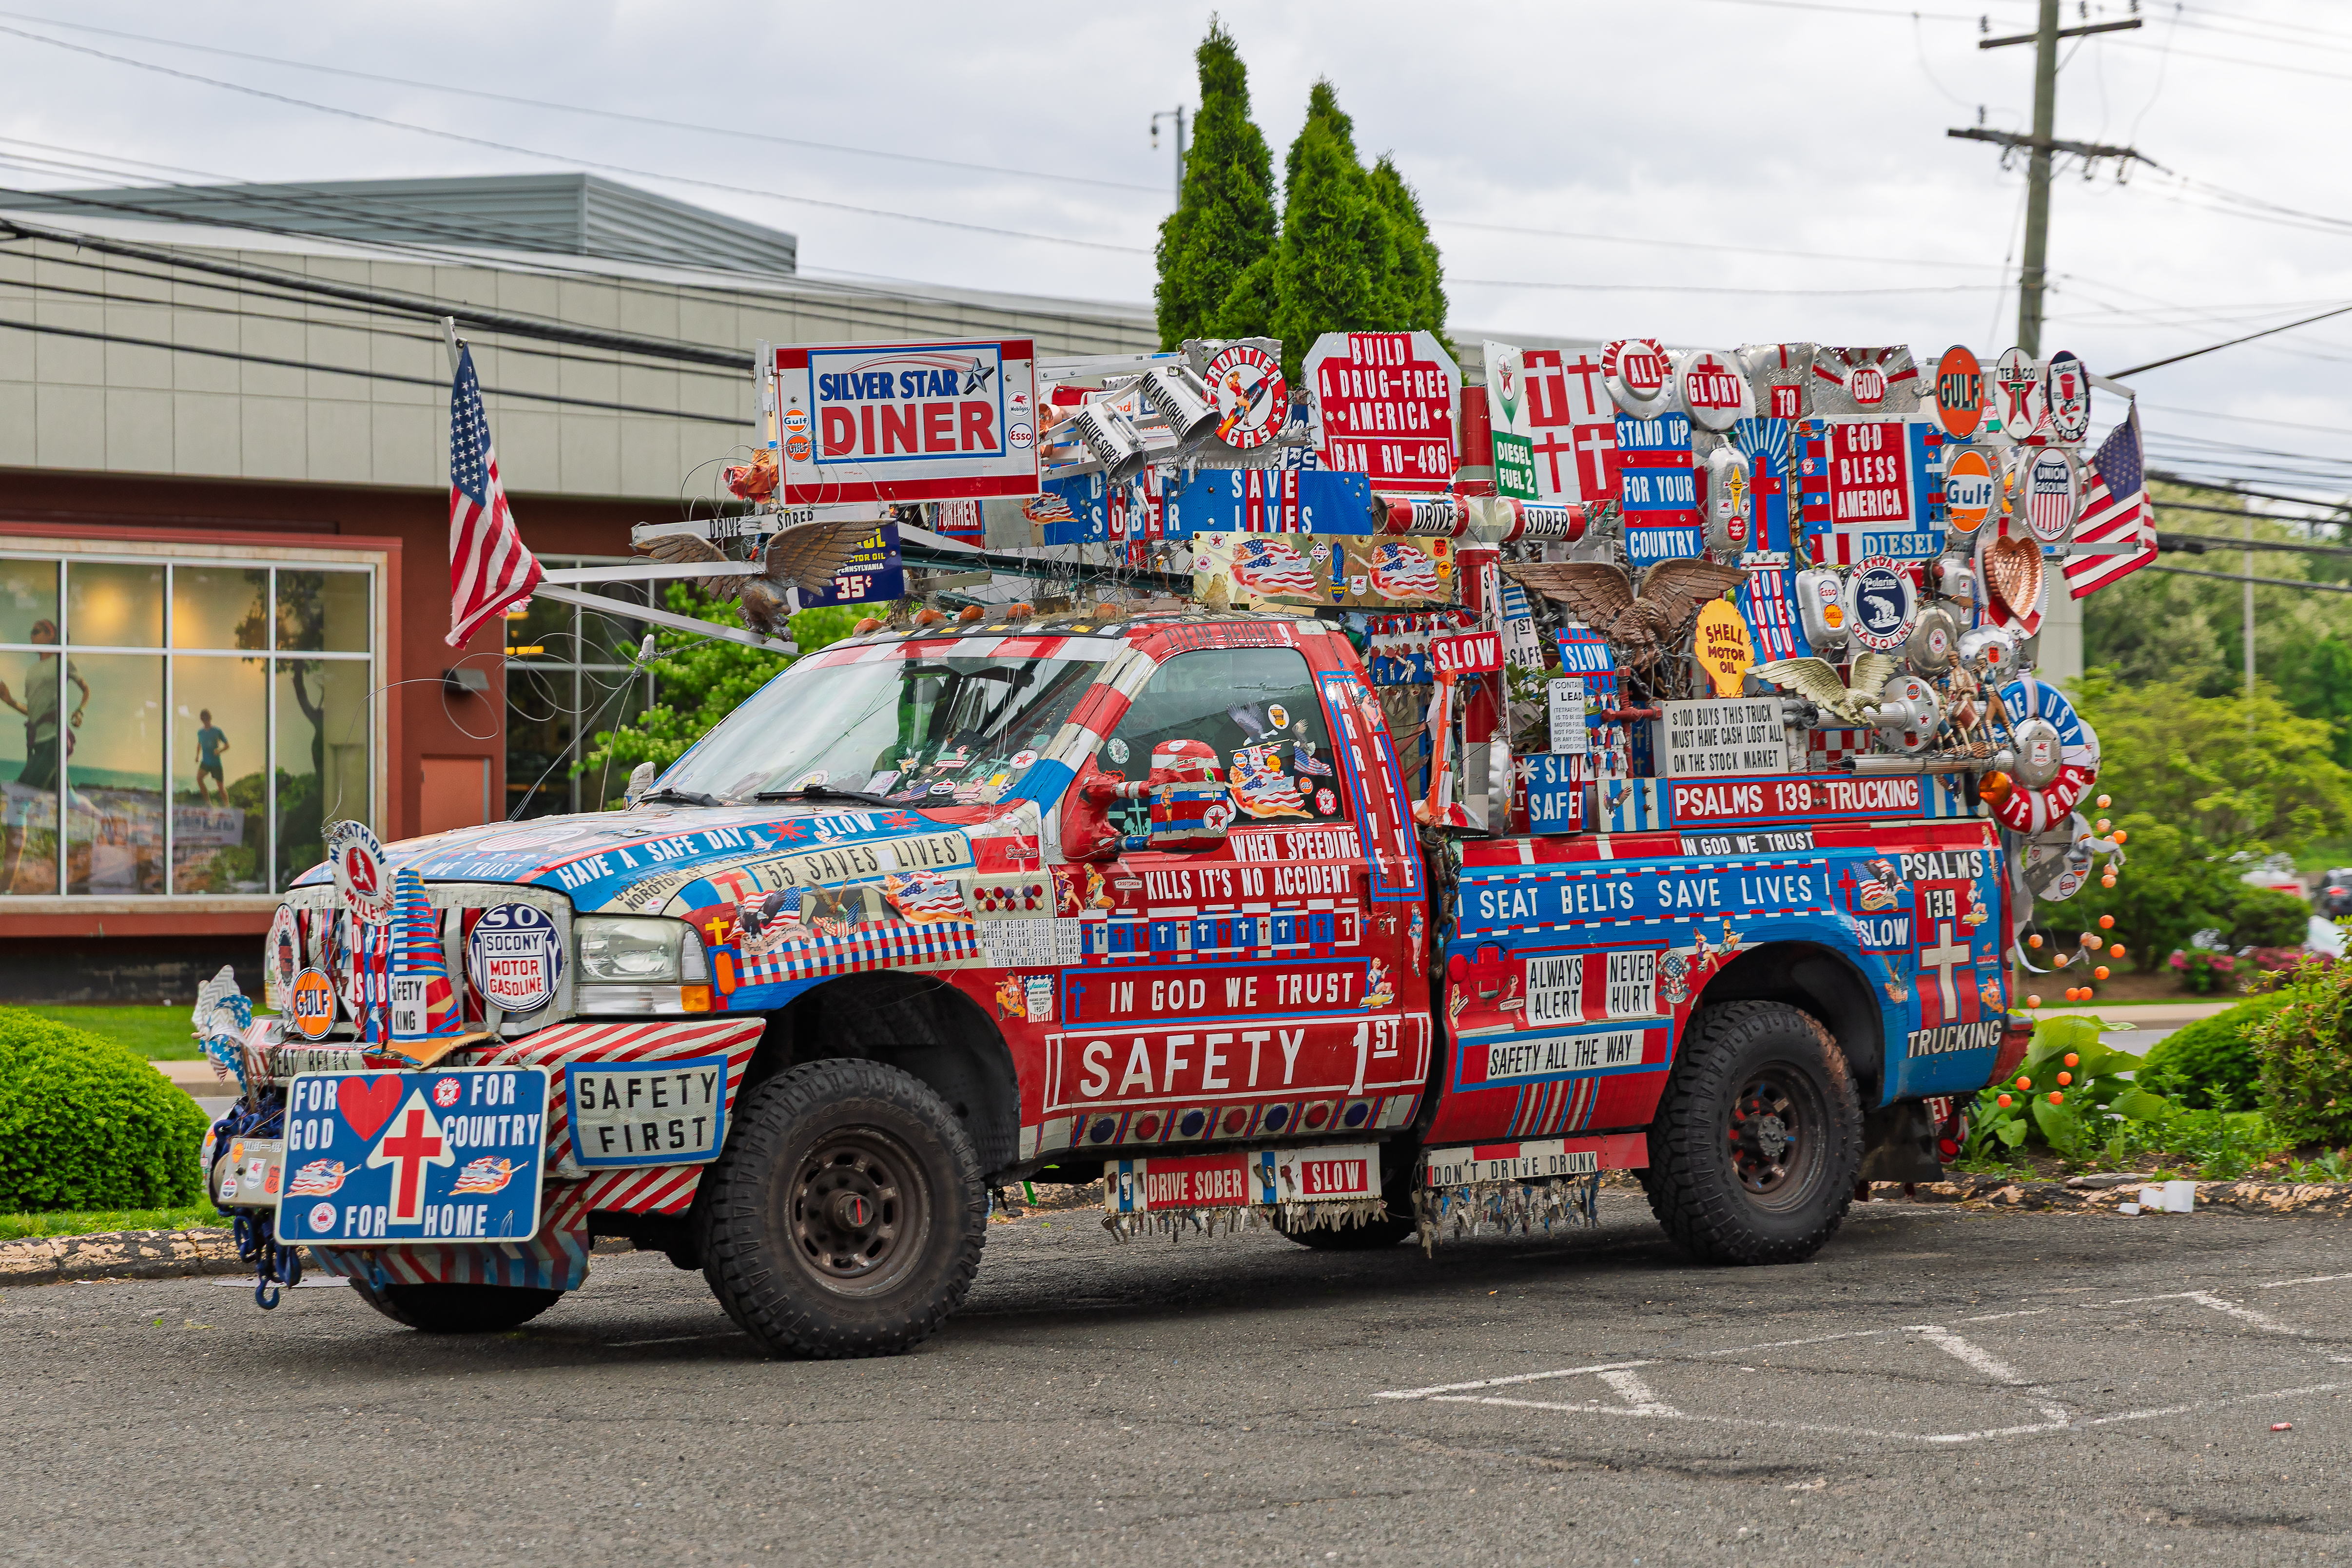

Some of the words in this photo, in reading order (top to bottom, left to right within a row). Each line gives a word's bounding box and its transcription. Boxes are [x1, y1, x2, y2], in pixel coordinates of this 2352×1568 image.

[1352, 338, 1405, 366] BUILD
[1141, 371, 1158, 392] NO
[1205, 345, 1284, 390] FRONTIER
[1630, 357, 1661, 384] ALL
[2000, 368, 2035, 380] TEXACO
[819, 371, 894, 401] SILVER
[900, 369, 959, 399] STAR
[1322, 371, 1332, 397] A
[1340, 369, 1446, 398] DRUG-FREE
[1688, 375, 1738, 404] GLORY
[1854, 372, 1882, 400] GOD
[1940, 374, 1981, 412] GULF
[1350, 402, 1429, 430] AMERICA
[1779, 389, 1796, 416] TO
[821, 401, 997, 456] DINER
[1011, 430, 1031, 440] Esso
[1075, 411, 1102, 445] DRIVE
[1226, 428, 1271, 447] GAS
[1617, 420, 1663, 447] STAND
[1670, 420, 1688, 445] UP
[1847, 424, 1882, 451] GOD
[788, 444, 808, 453] GULF
[1335, 444, 1368, 471] BAN
[1384, 445, 1446, 473] RU-486
[1497, 442, 1531, 465] DIESEL
[1500, 468, 1523, 490] FUEL
[1525, 472, 1535, 493] 2
[1841, 455, 1896, 485] BLESS
[2038, 466, 2066, 481] UNION
[1232, 471, 1296, 498] SAVE
[1623, 477, 1650, 503] FOR
[1656, 475, 1694, 502] YOUR
[1948, 480, 1992, 505] Gulf
[2035, 482, 2068, 494] GASOLINE
[938, 501, 978, 527] FURTHER
[1838, 489, 1902, 519] AMERICA
[709, 517, 741, 538] DRIVE
[1091, 503, 1180, 534] SOBER
[1235, 506, 1312, 533] LIVES
[1415, 504, 1453, 529] DRIVE
[1526, 509, 1569, 536] SOBER
[1630, 531, 1694, 558] COUNTRY
[1865, 532, 1936, 556] DIESEL
[1853, 556, 1907, 580] STANDARD
[836, 575, 872, 599] 35¢
[1752, 571, 1781, 598] GOD
[1863, 577, 1897, 589] Polarine
[1748, 600, 1795, 625] LOVES
[1513, 619, 1530, 643] 1ST
[1706, 624, 1743, 646] SHELL
[1760, 627, 1791, 653] YOU
[1853, 619, 1914, 648] GASOLINE
[1438, 638, 1495, 670] SLOW
[1510, 646, 1541, 665] SAFE
[1566, 645, 1608, 672] SLOW
[1708, 645, 1746, 661] MOTOR
[1720, 661, 1736, 674] OIL
[1561, 693, 1582, 701] LEAD
[1697, 707, 1719, 724] BUYS
[1724, 705, 1743, 724] THIS
[1747, 704, 1772, 722] TRUCK
[1672, 730, 1693, 748] MUST
[1698, 729, 1718, 746] HAVE
[1722, 727, 1742, 744] CASH
[1747, 726, 1767, 743] LOST
[1769, 724, 1783, 742] ALL
[1674, 755, 1686, 773] ON
[1689, 754, 1705, 771] THE
[1709, 752, 1738, 769] STOCK
[1744, 750, 1778, 768] MARKET
[1336, 685, 1388, 873] ARRIVE
[1374, 736, 1414, 887] ALIVE
[1675, 785, 1763, 816] PSALMS
[1776, 783, 1811, 811] 139
[1826, 780, 1918, 810] TRUCKING
[557, 854, 614, 890] HAVE
[618, 849, 639, 869] A
[646, 834, 700, 863] SAFE
[706, 827, 747, 850] DAY
[814, 813, 876, 837] SLOW
[1230, 834, 1281, 862] WHEN
[1287, 832, 1361, 861] SPEEDING
[1681, 838, 1695, 856] IN
[1701, 836, 1730, 855] GOD
[1737, 834, 1759, 853] WE
[1765, 832, 1814, 852] TRUST
[426, 861, 455, 876] WE
[462, 862, 523, 878] TRUST
[810, 847, 876, 881] SAVES
[1901, 852, 1983, 880] PSALMS
[1146, 871, 1191, 899] KILLS
[1200, 869, 1232, 897] IT'S
[1243, 868, 1263, 896] NO
[1275, 865, 1349, 895] ACCIDENT
[1480, 888, 1538, 919] SEAT
[1561, 882, 1634, 914] BELTS
[1658, 879, 1720, 908] SAVE
[1742, 875, 1812, 904] LIVES
[1925, 890, 1956, 918] 139
[487, 934, 539, 950] SOCONY
[1859, 918, 1909, 946] SLOW
[490, 960, 539, 975] MOTOR
[1530, 958, 1582, 989] ALWAYS
[1610, 955, 1653, 982] NEVER
[490, 977, 543, 996] GASOLINE
[1110, 981, 1134, 1013] IN
[1152, 979, 1205, 1010] GOD
[1226, 977, 1257, 1007] WE
[1276, 973, 1353, 1005] TRUST
[295, 990, 330, 1017] GULF
[1535, 990, 1579, 1020] ALERT
[1613, 985, 1650, 1012] HURT
[395, 1011, 416, 1030] KING
[1907, 1020, 2001, 1058] TRUCKING
[1080, 1028, 1305, 1097] SAFETY
[1348, 1020, 1400, 1095] 1ST
[1490, 1045, 1541, 1076] SAFETY
[1545, 1042, 1568, 1070] ALL
[1574, 1039, 1598, 1066] THE
[1607, 1034, 1633, 1063] WAY
[295, 1080, 337, 1111] FOR
[471, 1074, 516, 1106] FOR
[581, 1072, 717, 1110] SAFETY
[290, 1119, 334, 1150] GOD
[443, 1114, 540, 1146] COUNTRY
[599, 1116, 706, 1153] FIRST
[1312, 1161, 1360, 1192] SLOW
[1433, 1160, 1478, 1186] DON'T
[1490, 1156, 1541, 1181] DRIVE
[1549, 1152, 1597, 1174] DRUNK
[1148, 1172, 1188, 1202] DRIVE
[1194, 1168, 1243, 1200] SOBER
[345, 1205, 387, 1237] FOR
[425, 1204, 487, 1236] HOME
